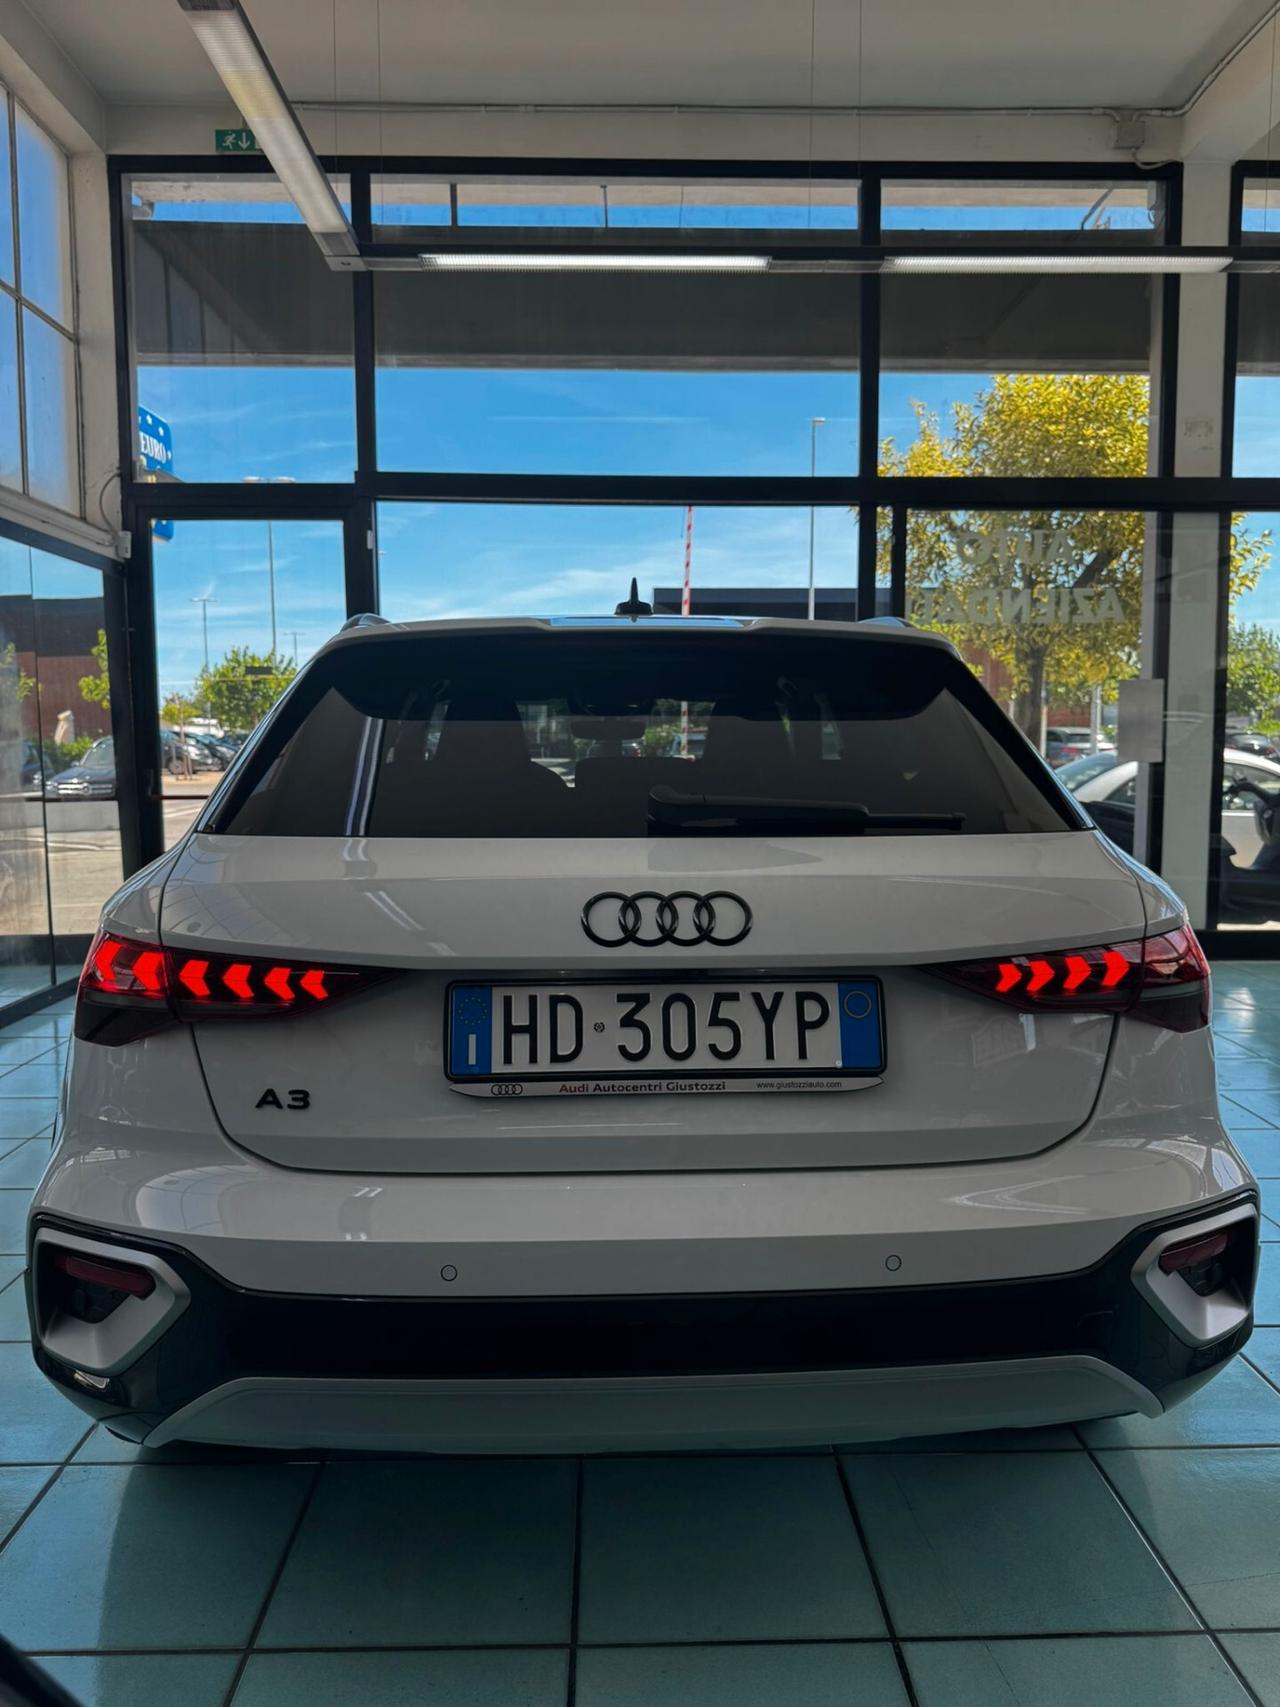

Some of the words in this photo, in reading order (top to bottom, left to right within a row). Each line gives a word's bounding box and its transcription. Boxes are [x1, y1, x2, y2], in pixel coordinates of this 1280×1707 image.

[503, 994, 583, 1065] HD
[616, 990, 831, 1062] 305YP
[559, 1083, 590, 1094] Audi
[593, 1081, 663, 1093] Autocentri
[666, 1080, 727, 1092] Giustozzi
[756, 1079, 843, 1090] www.giustozziauto.com
[255, 1088, 310, 1110] A3
